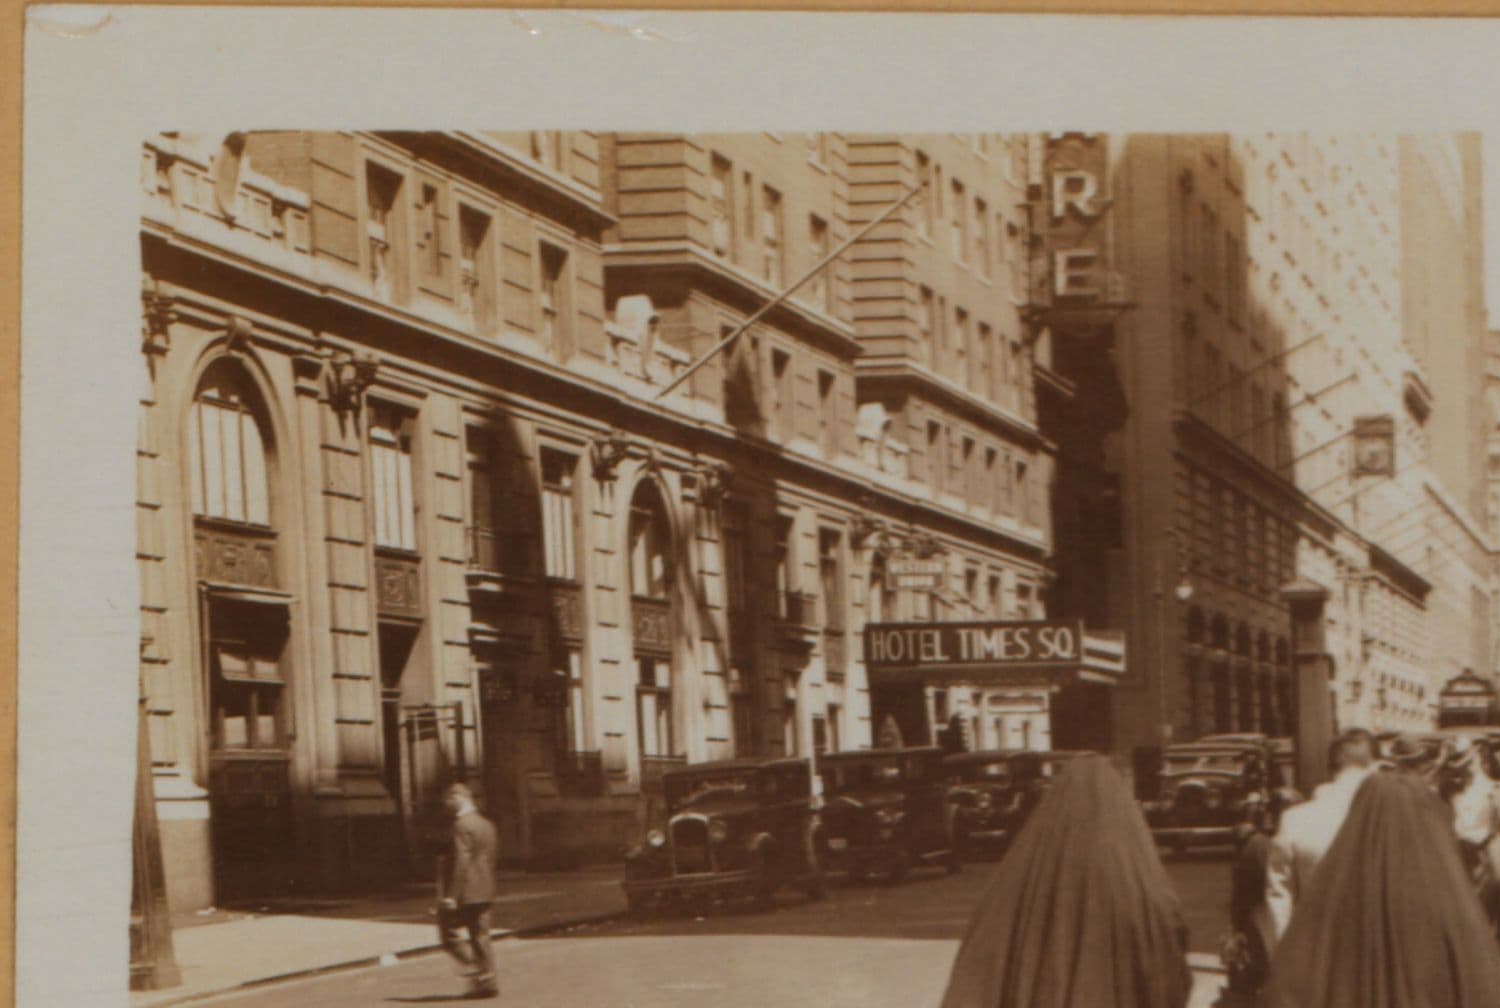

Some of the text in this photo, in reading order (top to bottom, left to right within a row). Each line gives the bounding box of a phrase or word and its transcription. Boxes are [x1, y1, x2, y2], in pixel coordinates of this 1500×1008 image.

[1052, 132, 1101, 296] RE
[870, 629, 950, 661] HOTEL
[956, 627, 1031, 660] TIMES
